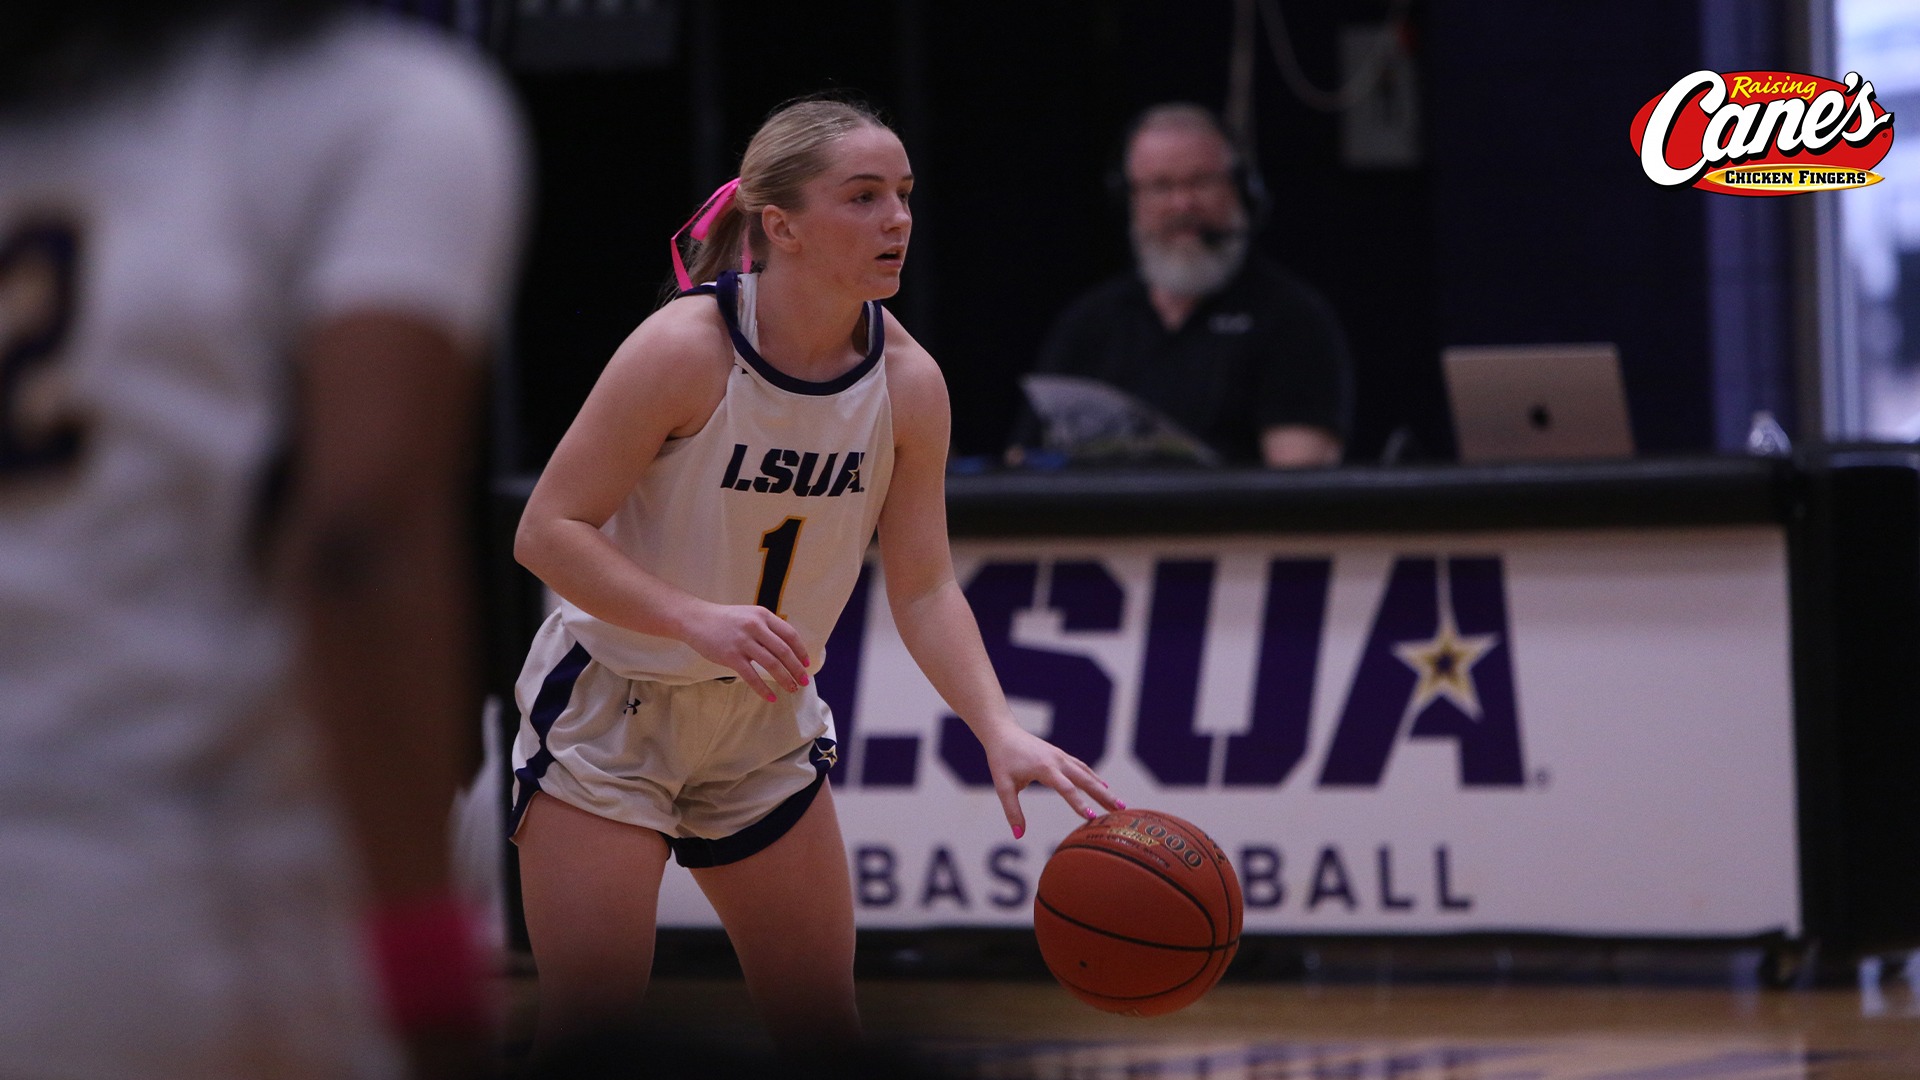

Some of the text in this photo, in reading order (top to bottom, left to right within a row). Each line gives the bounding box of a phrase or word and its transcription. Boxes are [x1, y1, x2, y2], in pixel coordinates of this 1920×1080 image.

[720, 443, 866, 498] LSUA
[753, 514, 807, 622] 1
[1127, 817, 1203, 868] 1000
[855, 845, 1473, 909] BASBALL
